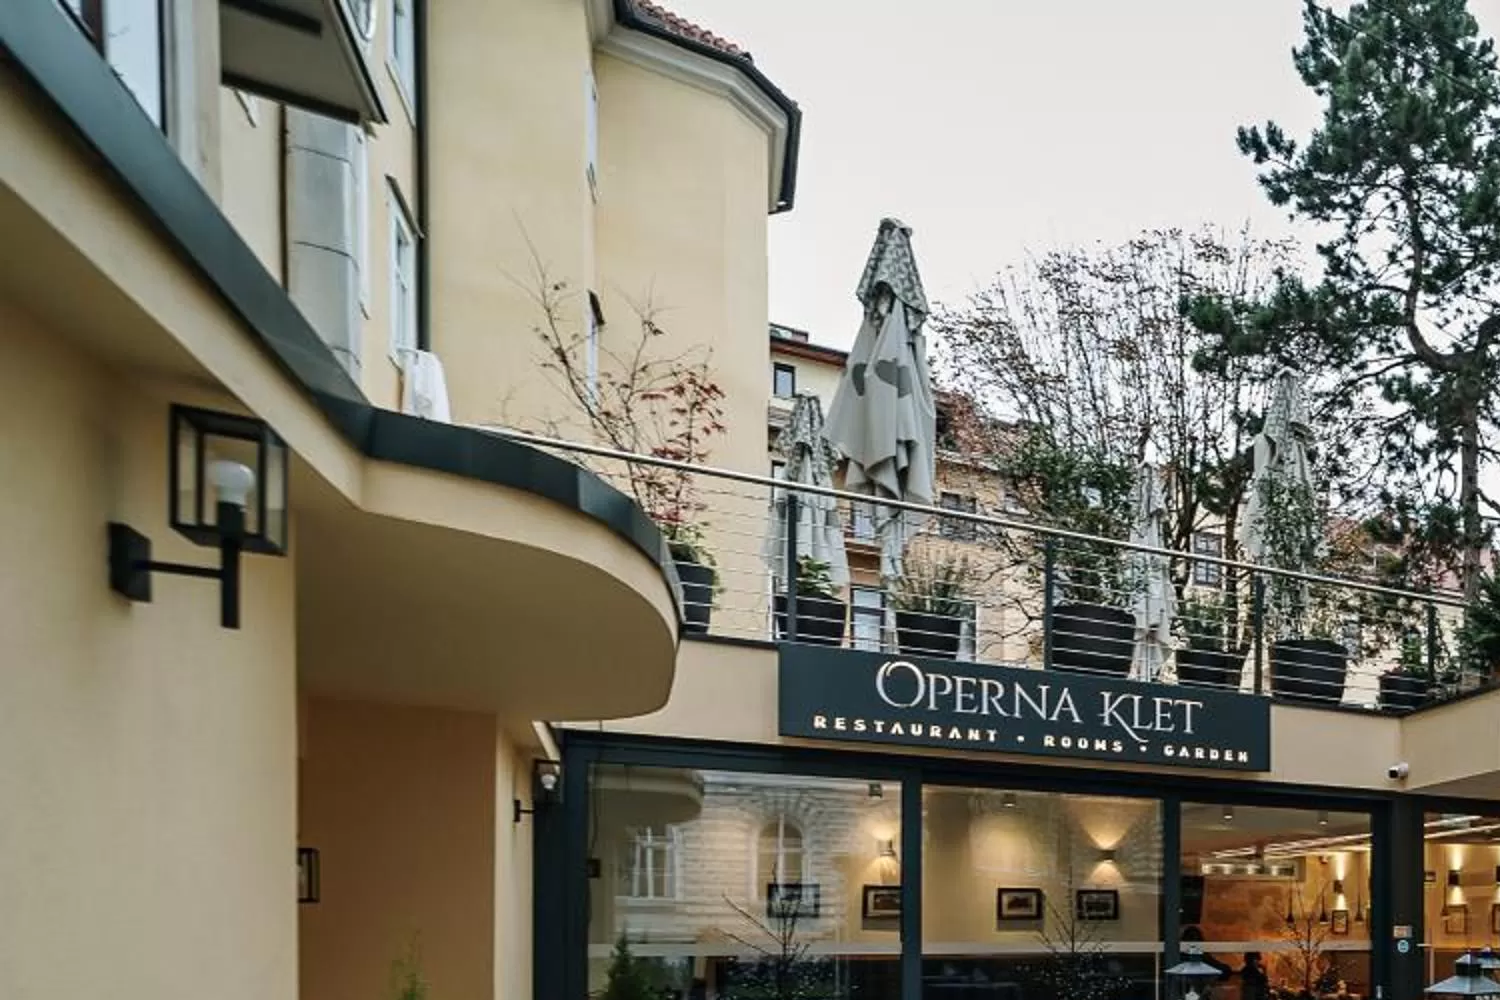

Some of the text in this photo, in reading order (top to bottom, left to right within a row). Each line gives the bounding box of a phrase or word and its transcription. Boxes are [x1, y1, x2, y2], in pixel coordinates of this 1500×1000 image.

[876, 661, 1203, 743] OPERNA KLET
[814, 715, 1249, 763] RESTAURANT ROOMS GARDEN
